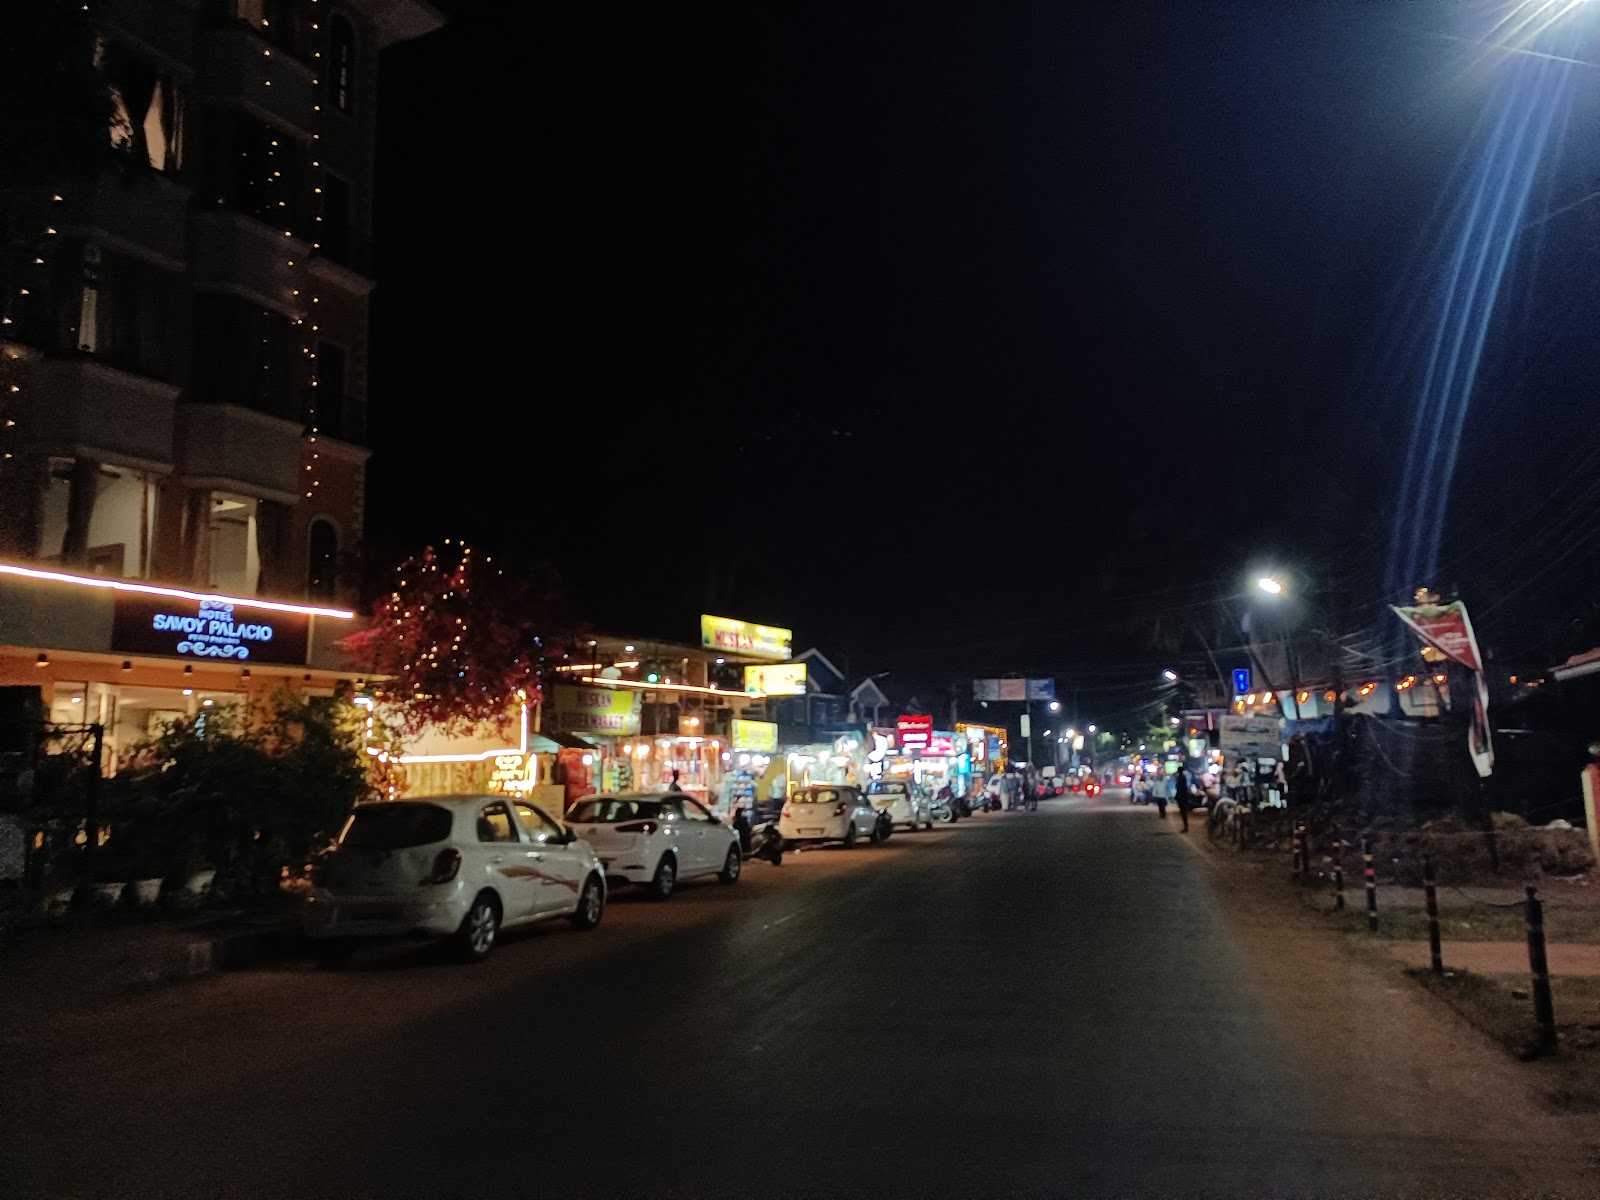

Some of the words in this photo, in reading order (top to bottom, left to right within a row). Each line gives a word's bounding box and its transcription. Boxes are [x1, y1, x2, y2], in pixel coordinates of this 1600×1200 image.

[199, 609, 233, 622] HOTEL
[152, 614, 207, 633] SAVOY
[208, 620, 273, 641] PALACIO
